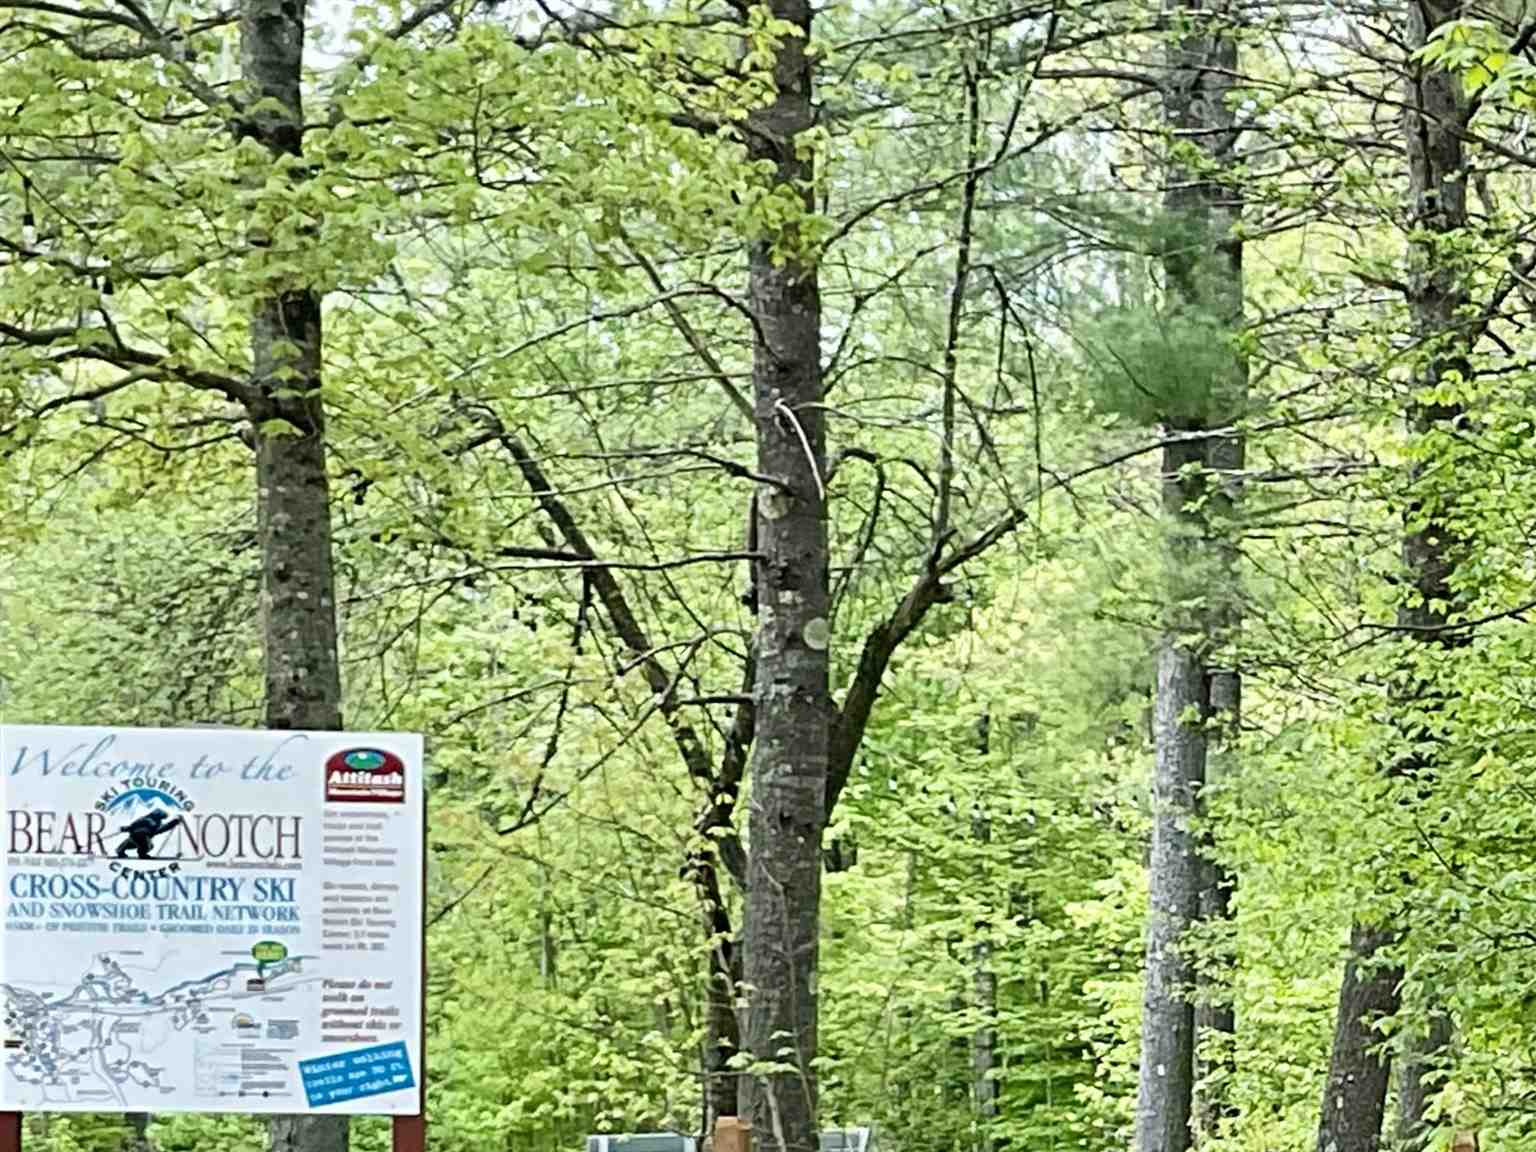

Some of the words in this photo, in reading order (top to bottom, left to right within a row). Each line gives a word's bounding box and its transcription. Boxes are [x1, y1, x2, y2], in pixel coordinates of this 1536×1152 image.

[10, 734, 176, 778] Welcome
[190, 754, 232, 779] to
[240, 734, 309, 781] the
[94, 787, 119, 812] SKI
[120, 777, 195, 812] TOURING
[7, 810, 108, 856] BEAR
[175, 812, 303, 859] NOTCH
[10, 872, 247, 902] CROSS-COUNTRY
[253, 876, 297, 902] SKI
[109, 861, 181, 881] CENTER
[7, 902, 45, 918] AND
[49, 902, 152, 920] SNOWSHOE
[157, 903, 208, 921] TRAIL
[213, 904, 302, 922] NETWORK
